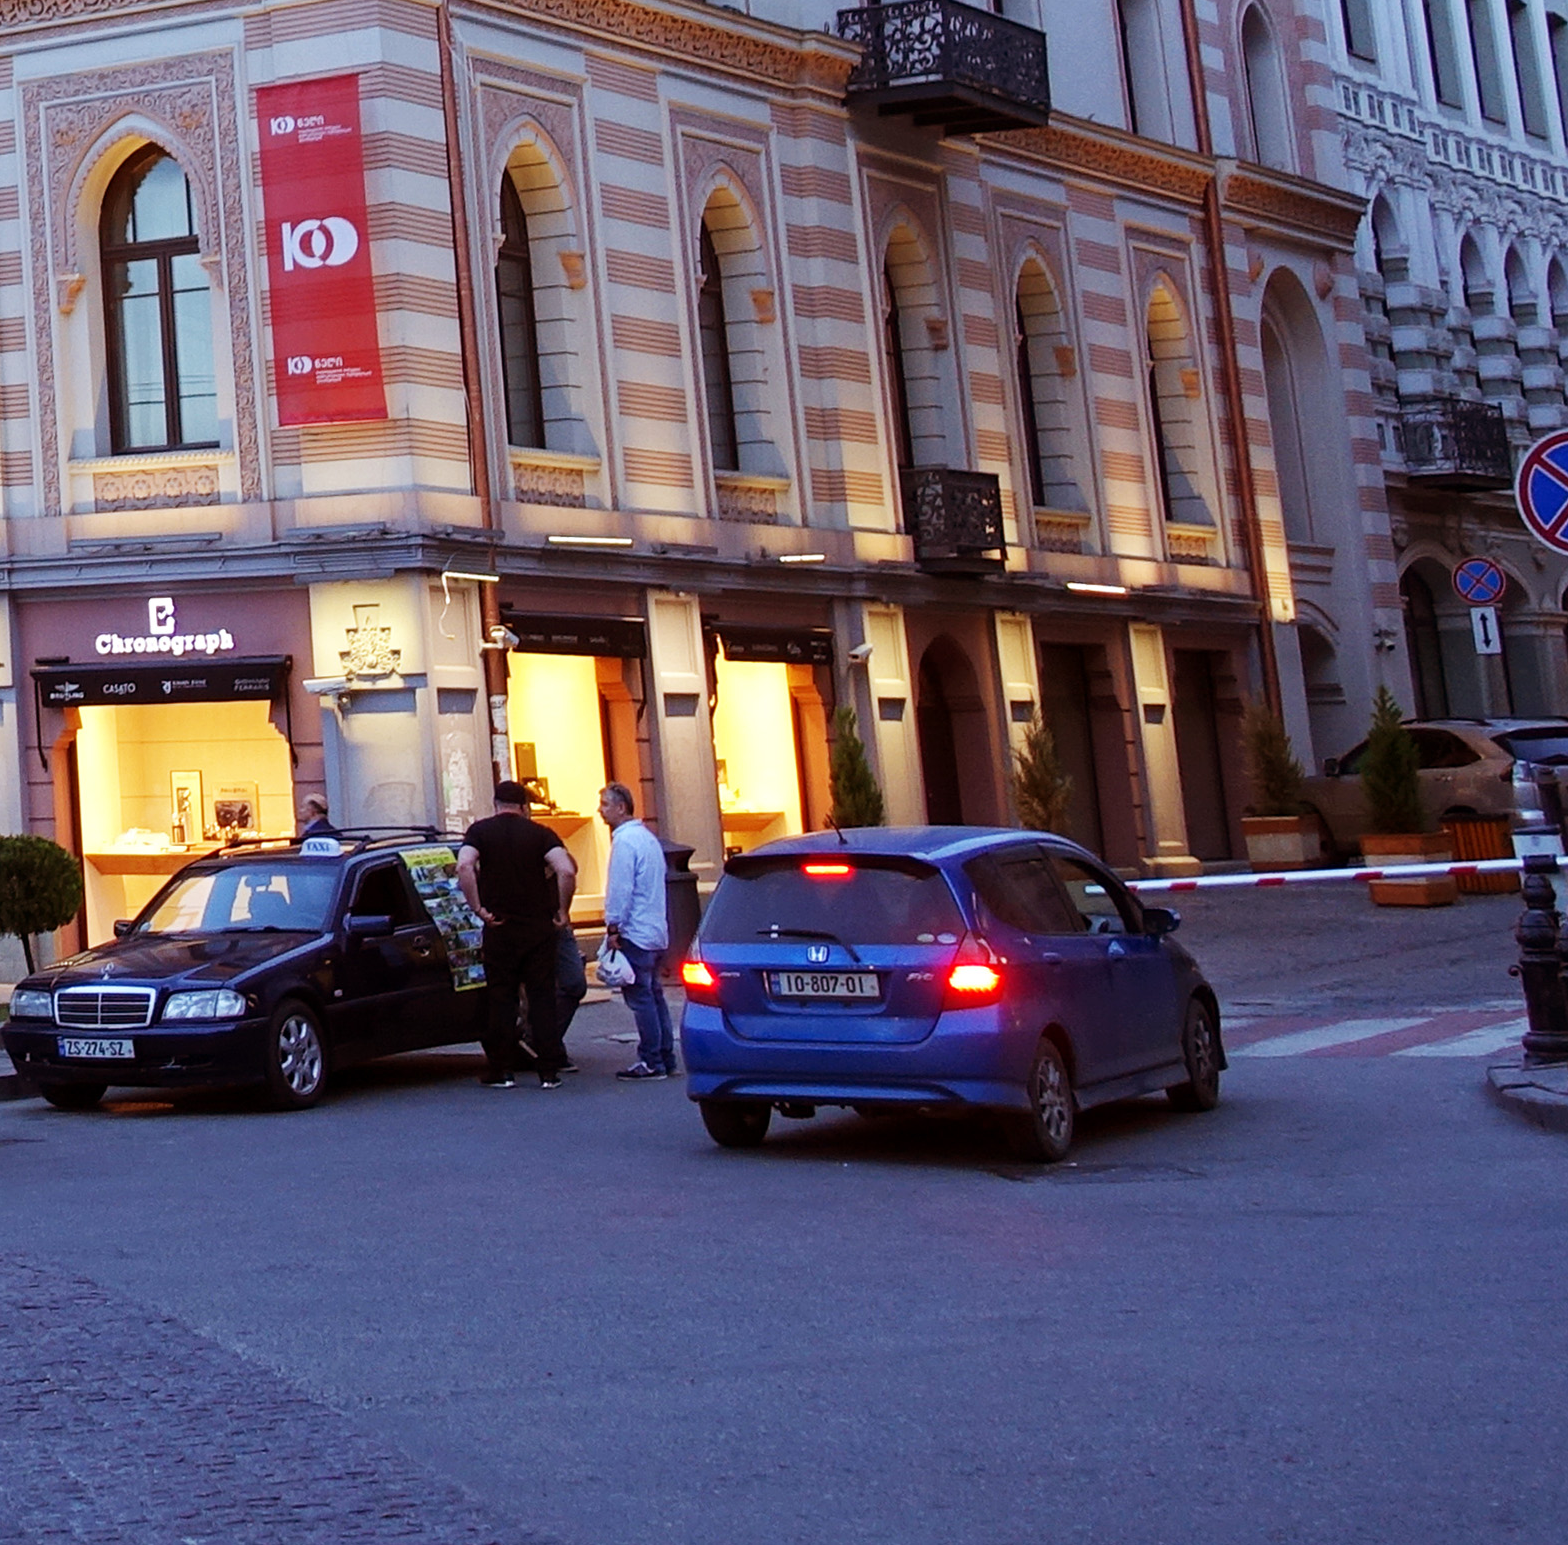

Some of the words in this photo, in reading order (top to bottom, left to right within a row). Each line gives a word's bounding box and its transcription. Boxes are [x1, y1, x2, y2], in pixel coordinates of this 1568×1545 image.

[280, 216, 360, 273] 100
[95, 628, 235, 656] Chronograph
[306, 841, 330, 853] TAXI
[66, 1040, 125, 1056] ZS-274-SZ
